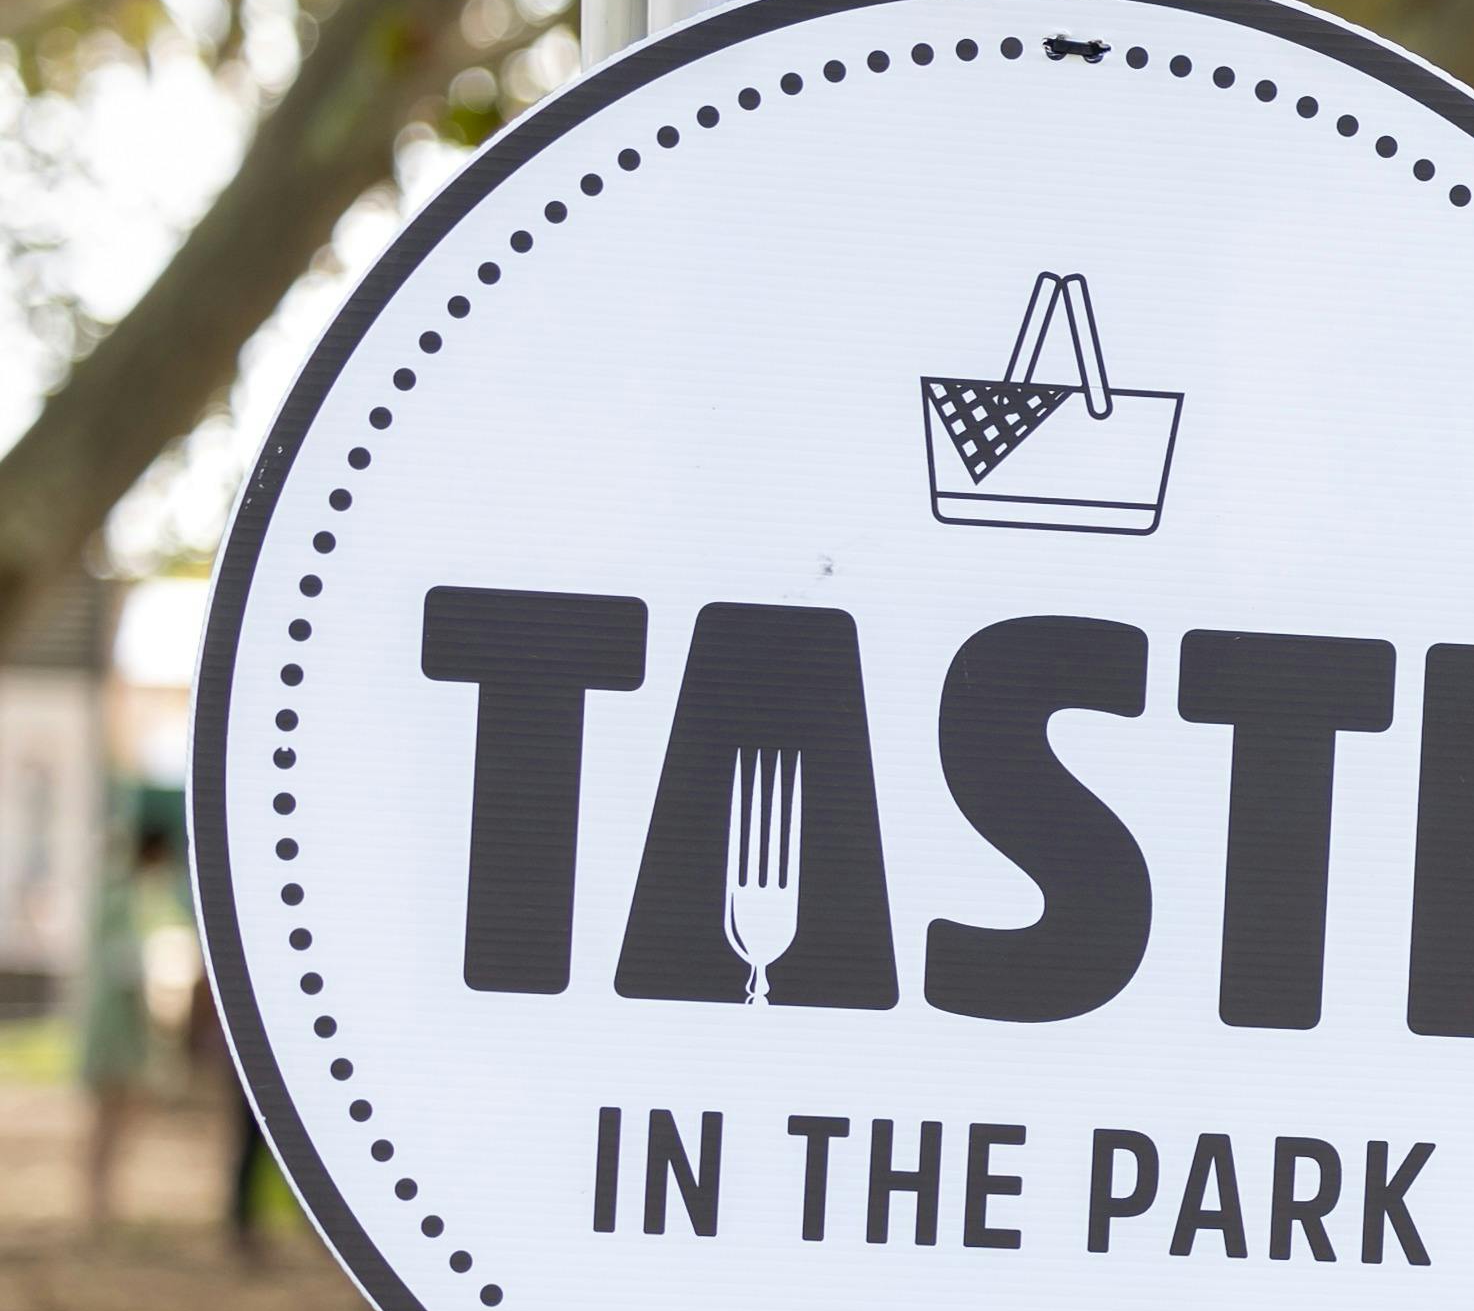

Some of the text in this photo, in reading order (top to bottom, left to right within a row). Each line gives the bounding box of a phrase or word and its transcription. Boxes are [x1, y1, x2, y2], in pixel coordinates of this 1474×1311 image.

[593, 1106, 1436, 1267] IN THE PARK
